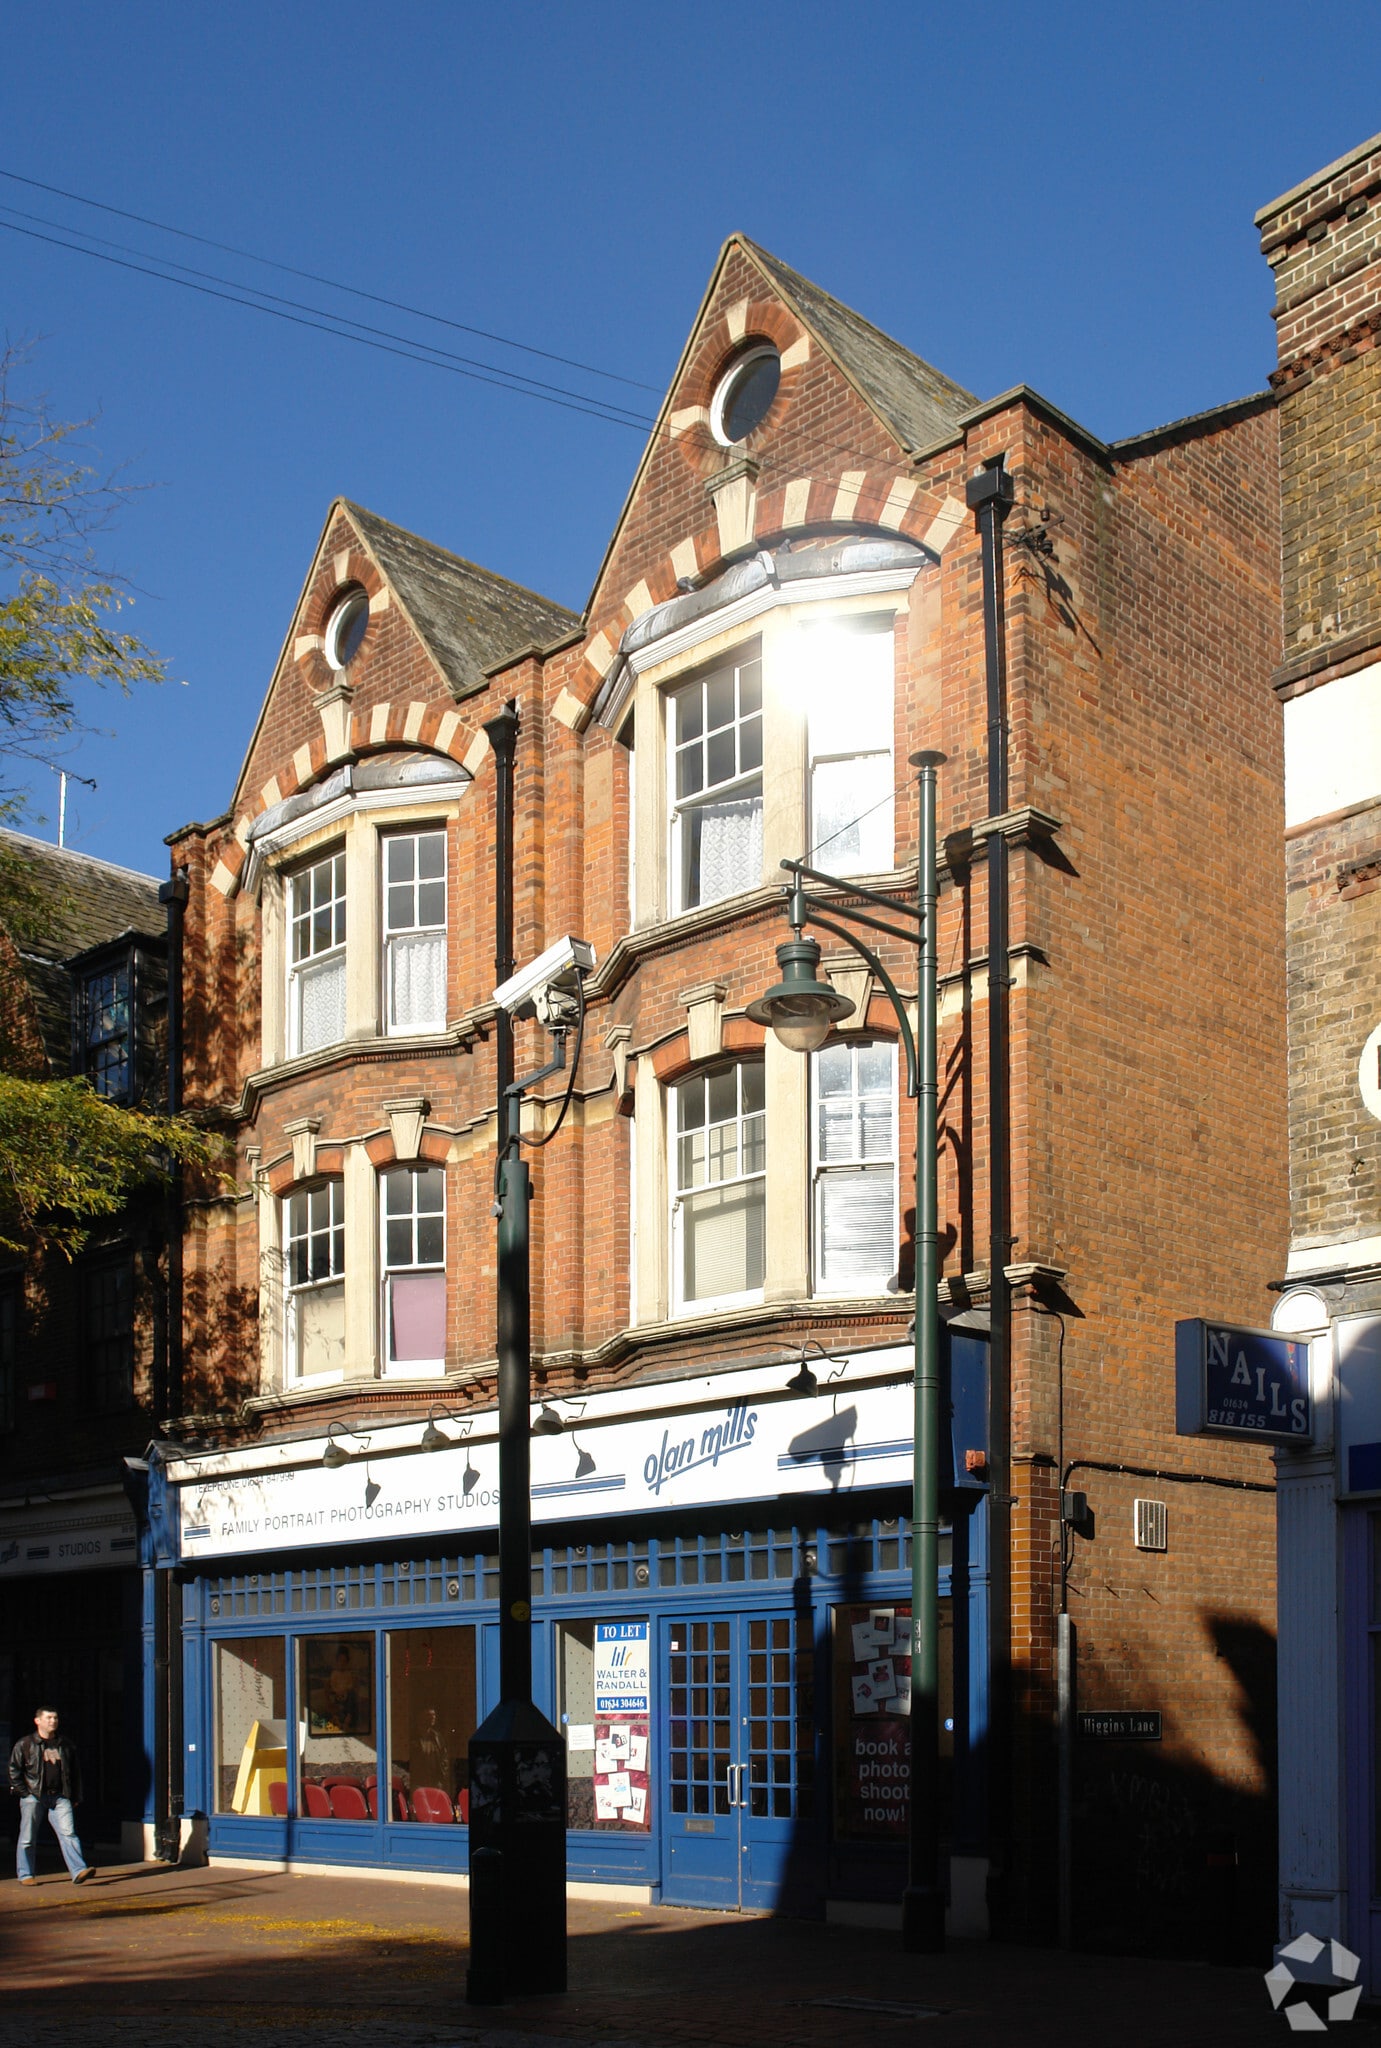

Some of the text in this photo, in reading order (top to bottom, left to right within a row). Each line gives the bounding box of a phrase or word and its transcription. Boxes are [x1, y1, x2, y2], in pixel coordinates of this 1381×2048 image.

[1207, 1330, 1307, 1433] NAILS
[1222, 1397, 1249, 1411] 01634
[1208, 1409, 1267, 1428] 818 155
[643, 1397, 758, 1496] olan mills
[221, 1489, 500, 1537] FAMILY PORTRAIT PHOTOGRAPHY STUDIOS
[58, 1540, 101, 1558] STUDIOS
[602, 1624, 641, 1639] TO LET
[597, 1668, 647, 1679] WALTER &
[596, 1680, 647, 1690] RANDALL
[1084, 1717, 1155, 1736] Higgins Lane
[855, 1738, 912, 1756] book a
[858, 1760, 910, 1781] photo
[860, 1782, 911, 1800] shoot
[864, 1804, 905, 1822] now!
